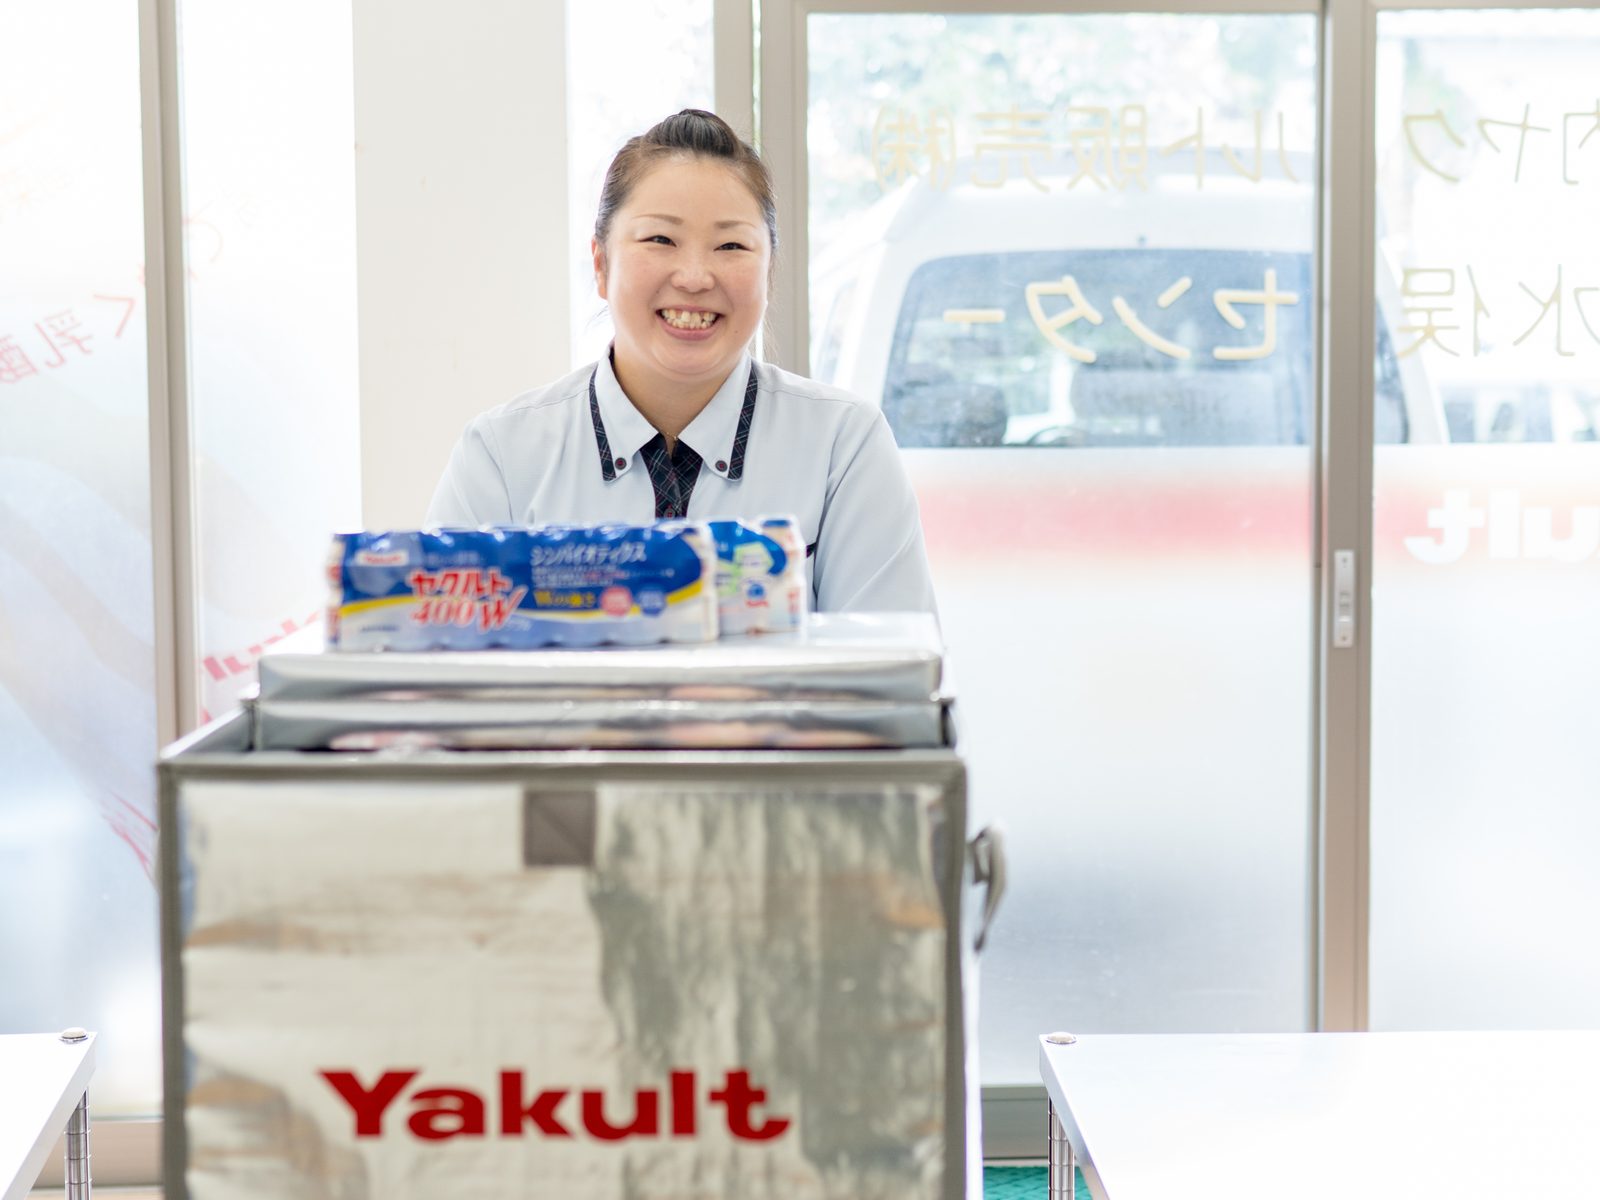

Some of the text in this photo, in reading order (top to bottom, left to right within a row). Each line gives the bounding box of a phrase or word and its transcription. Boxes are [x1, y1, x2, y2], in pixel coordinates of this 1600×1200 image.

[408, 566, 512, 598] ヤクルト
[317, 1068, 792, 1142] Yakult
